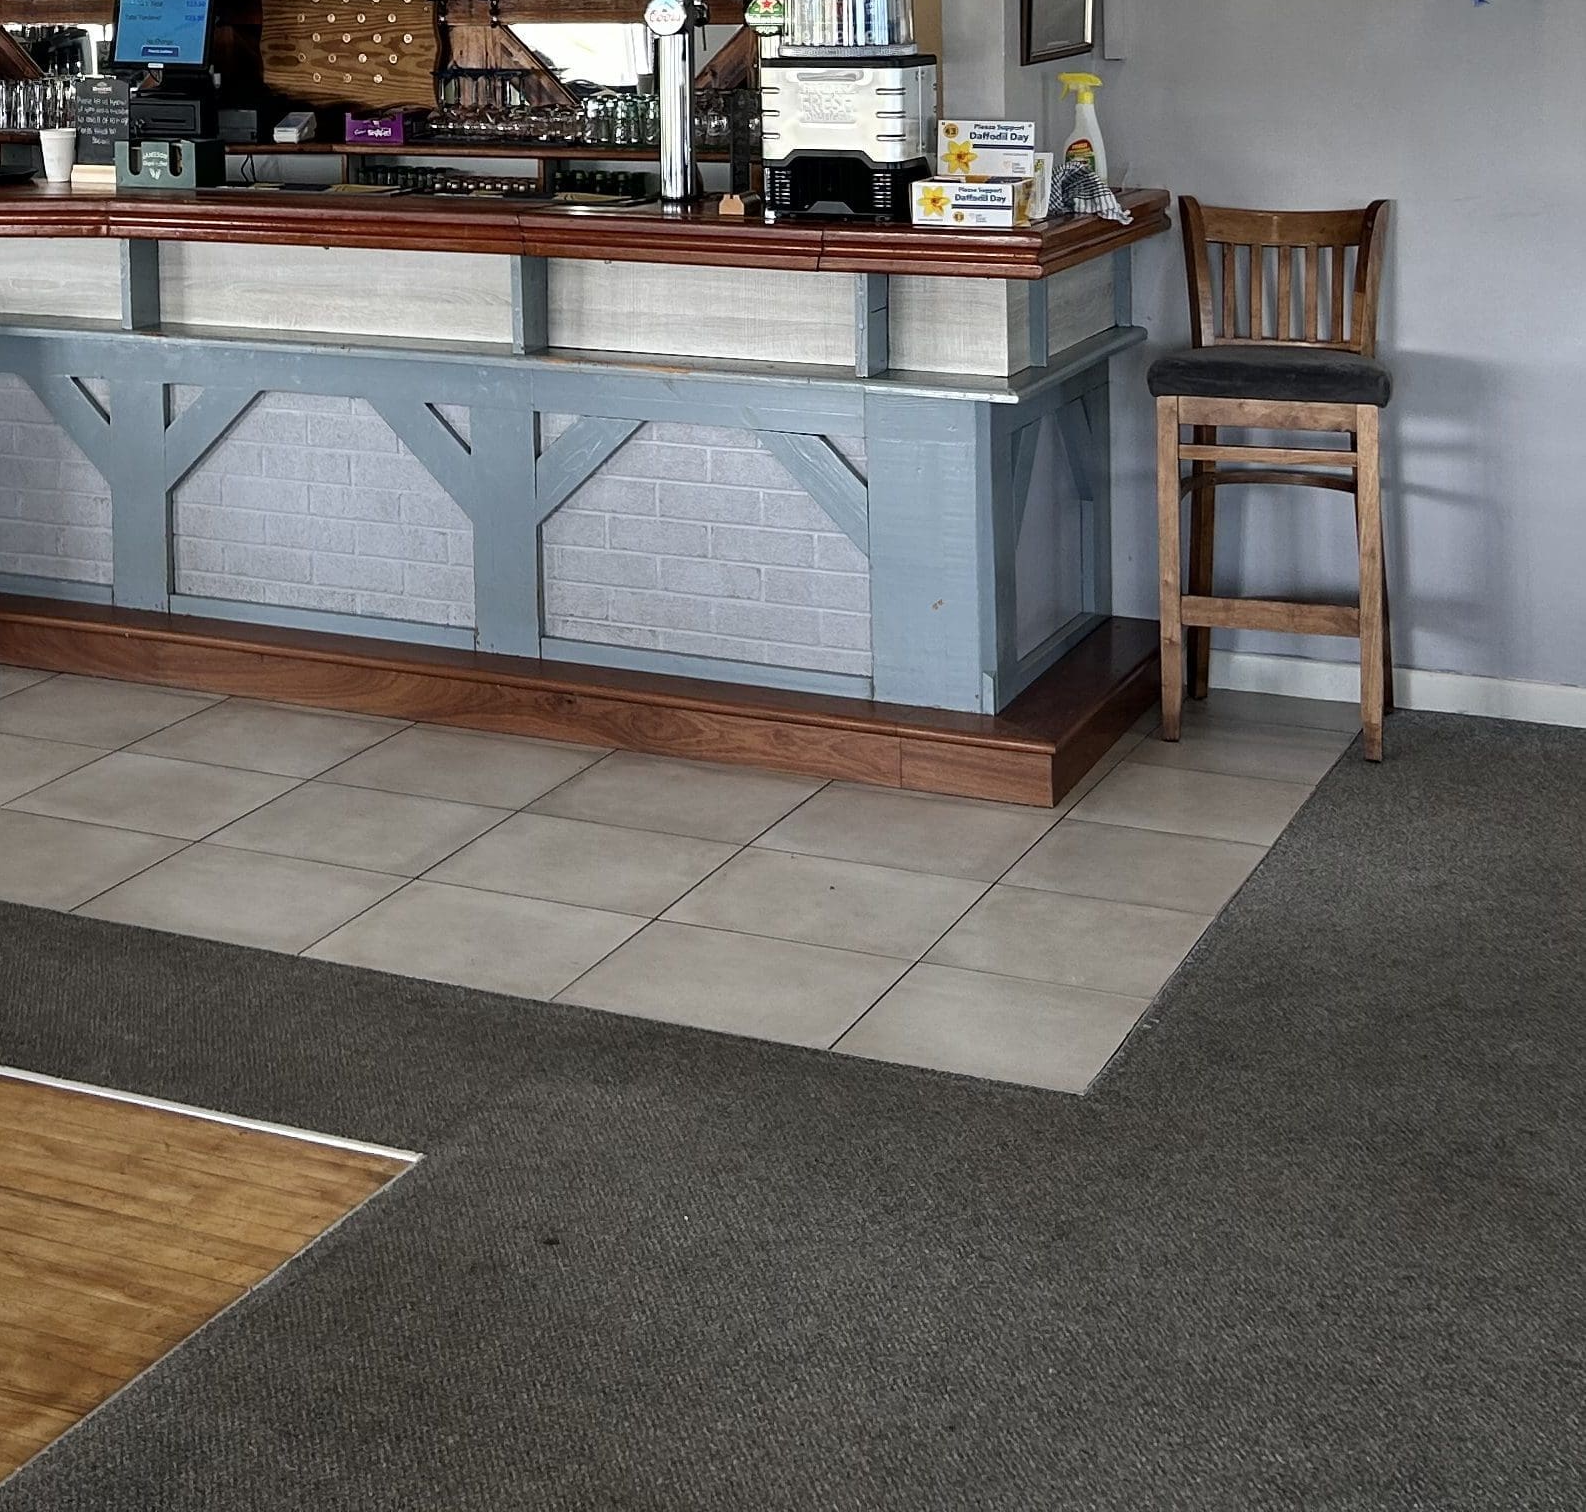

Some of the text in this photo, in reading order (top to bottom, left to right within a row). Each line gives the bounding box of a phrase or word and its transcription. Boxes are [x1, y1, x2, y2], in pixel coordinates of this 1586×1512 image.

[970, 132, 1029, 143] Daffodil Day
[955, 194, 1007, 204] Daffodil Day
